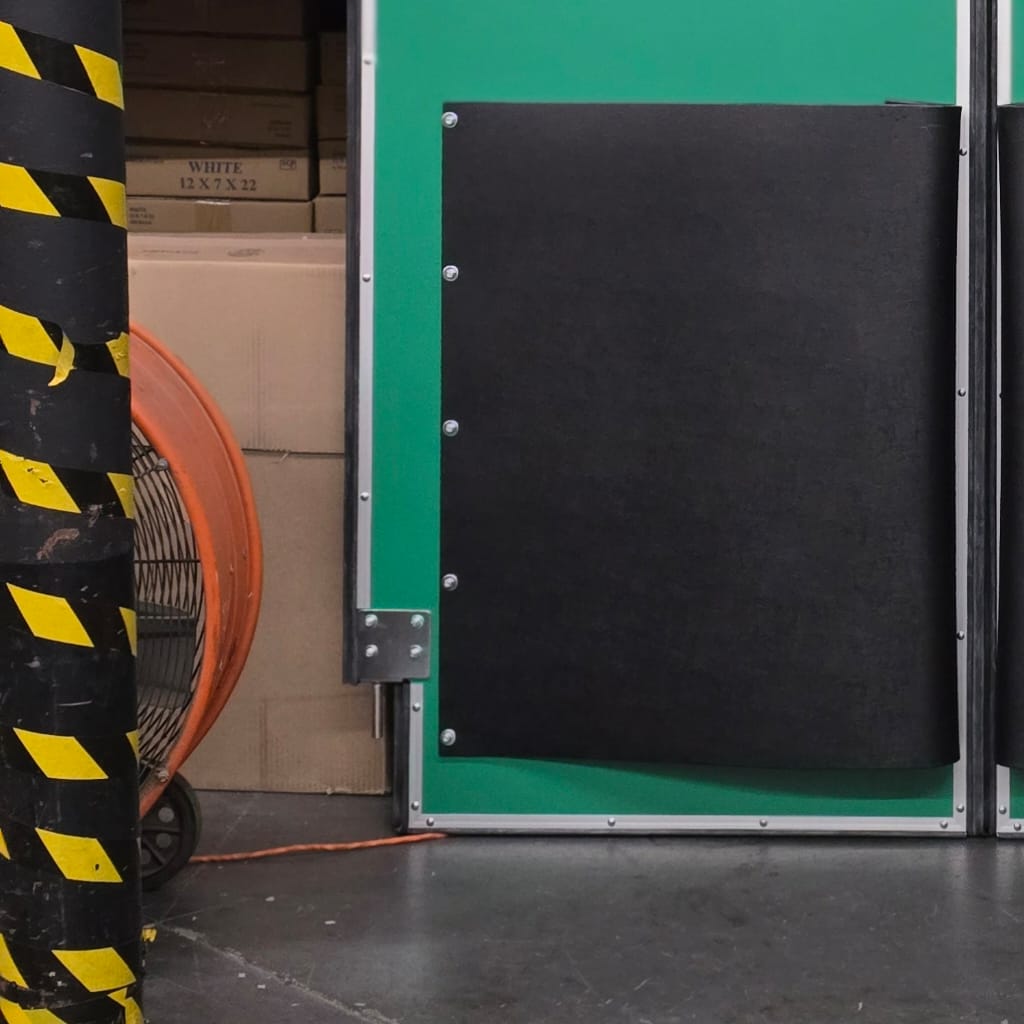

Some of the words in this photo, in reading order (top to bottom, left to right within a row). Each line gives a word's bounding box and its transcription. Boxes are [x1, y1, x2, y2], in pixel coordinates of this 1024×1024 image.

[188, 161, 243, 174] WHITE
[180, 177, 194, 190] 12
[199, 177, 210, 190] X
[214, 177, 221, 191] 7
[226, 178, 237, 191] X
[241, 179, 257, 191] 22
